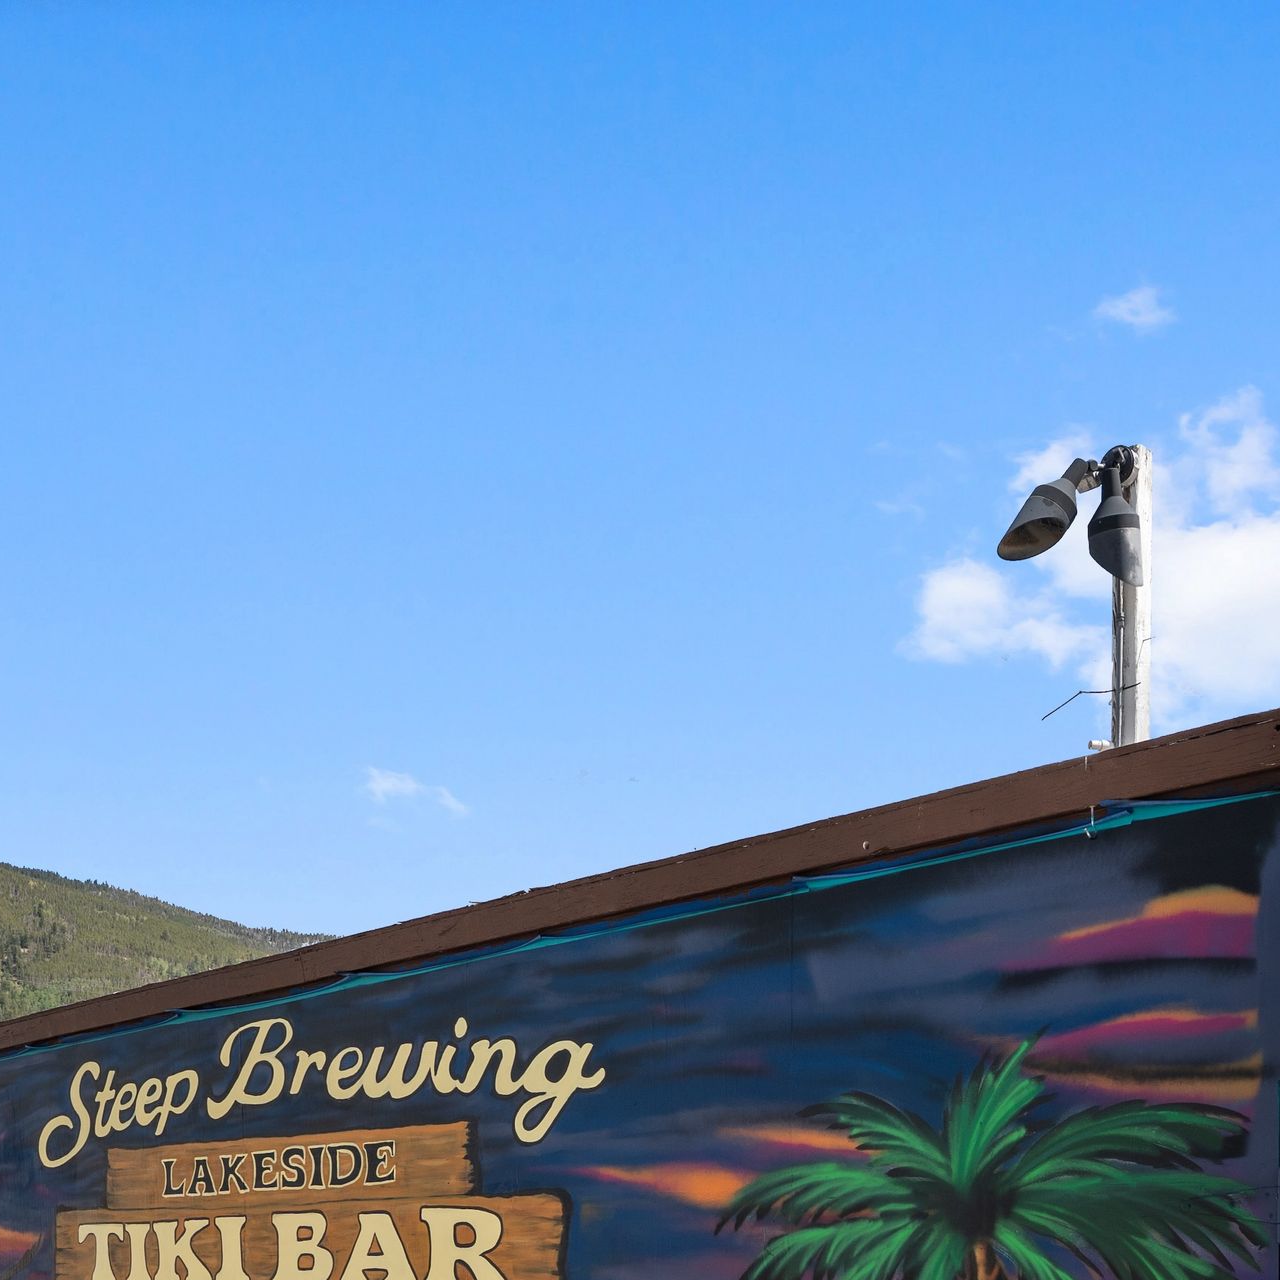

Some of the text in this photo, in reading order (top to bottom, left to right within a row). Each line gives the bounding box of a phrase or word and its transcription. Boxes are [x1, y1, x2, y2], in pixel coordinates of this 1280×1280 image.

[38, 1016, 605, 1168] Steep Brewing
[161, 1139, 396, 1198] LAKESIDE
